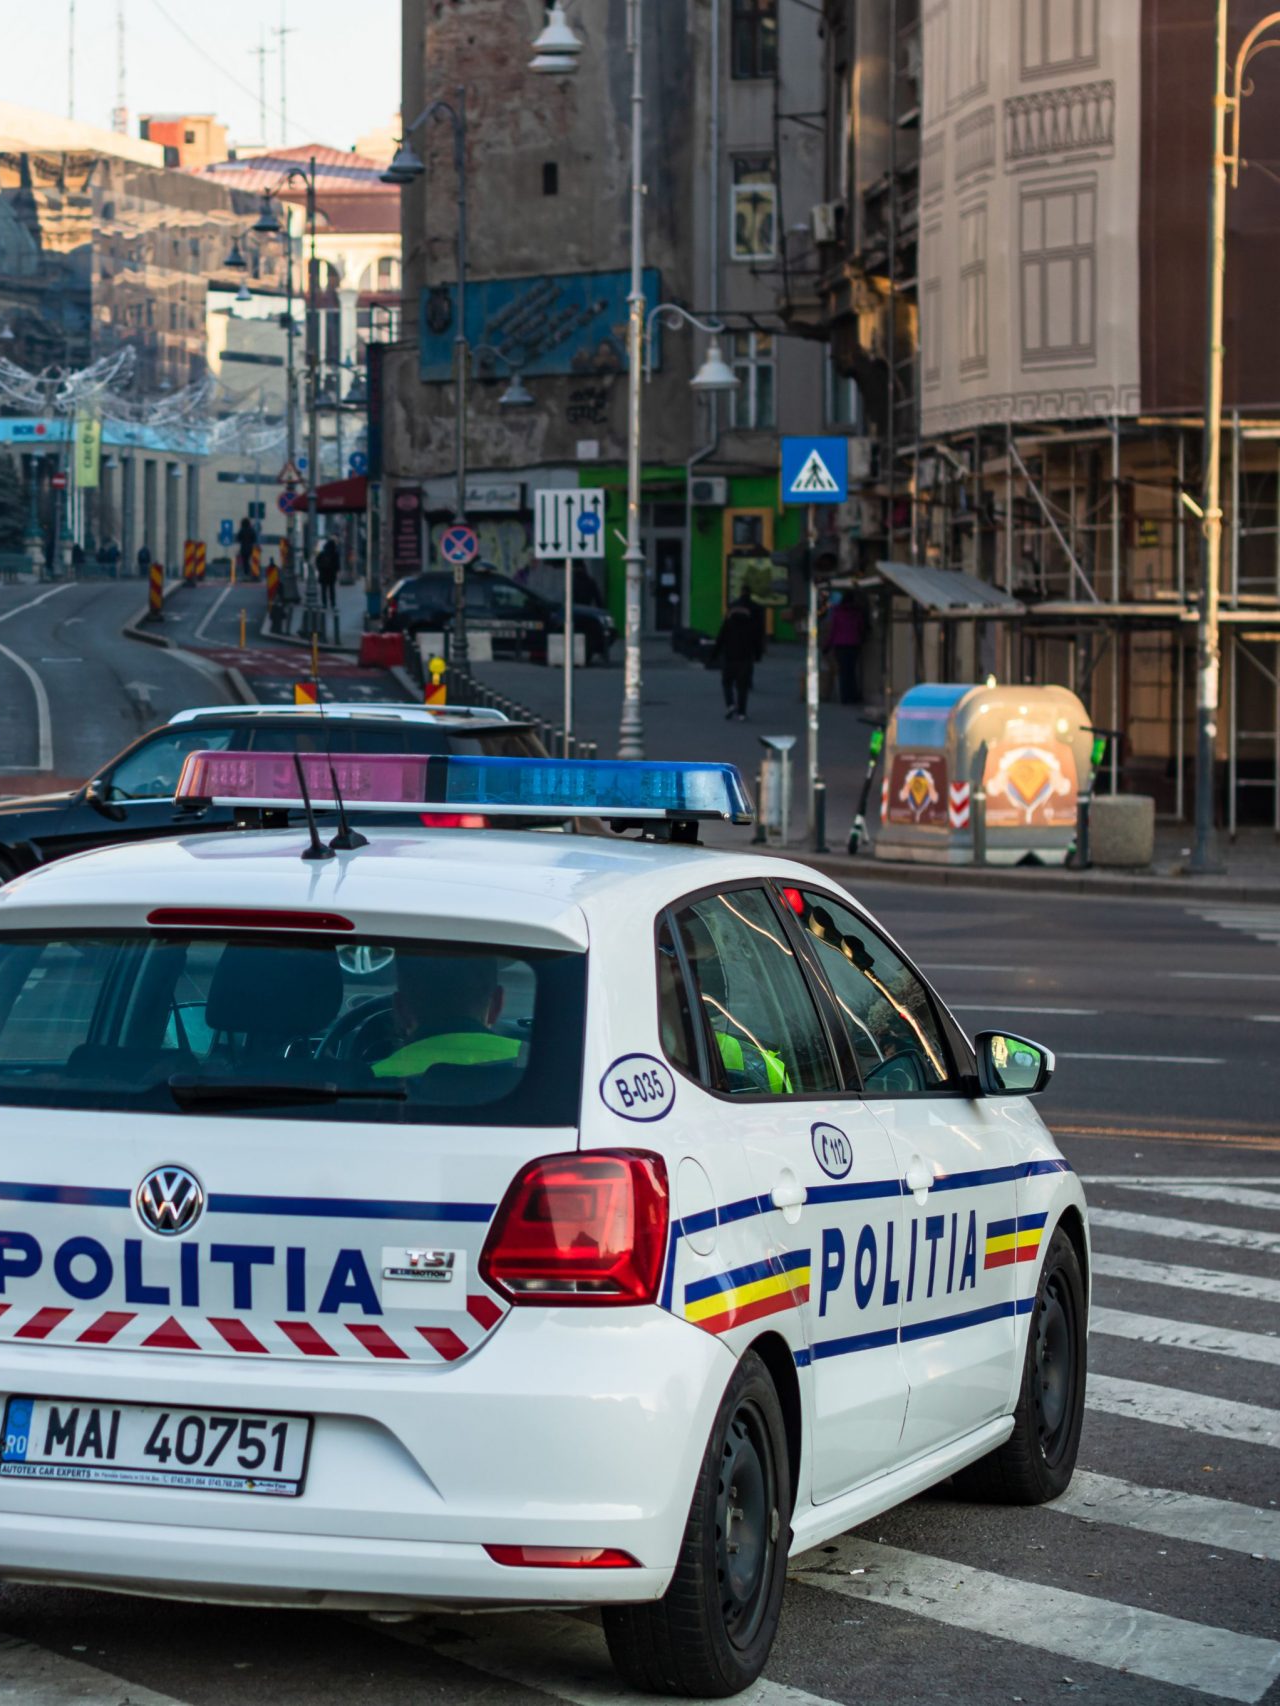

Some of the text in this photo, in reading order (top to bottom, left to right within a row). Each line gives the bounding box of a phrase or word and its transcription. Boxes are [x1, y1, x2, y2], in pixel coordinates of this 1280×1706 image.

[615, 1069, 665, 1108] B-035
[830, 1138, 848, 1166] 112
[406, 1249, 455, 1269] TSI
[819, 1209, 976, 1317] POLITIA
[6, 1434, 26, 1454] RO
[43, 1406, 289, 1472] MAI 40751
[2, 1463, 37, 1475] AUTOTEX
[38, 1466, 55, 1476] CAR
[56, 1467, 91, 1478] EXPERTS
